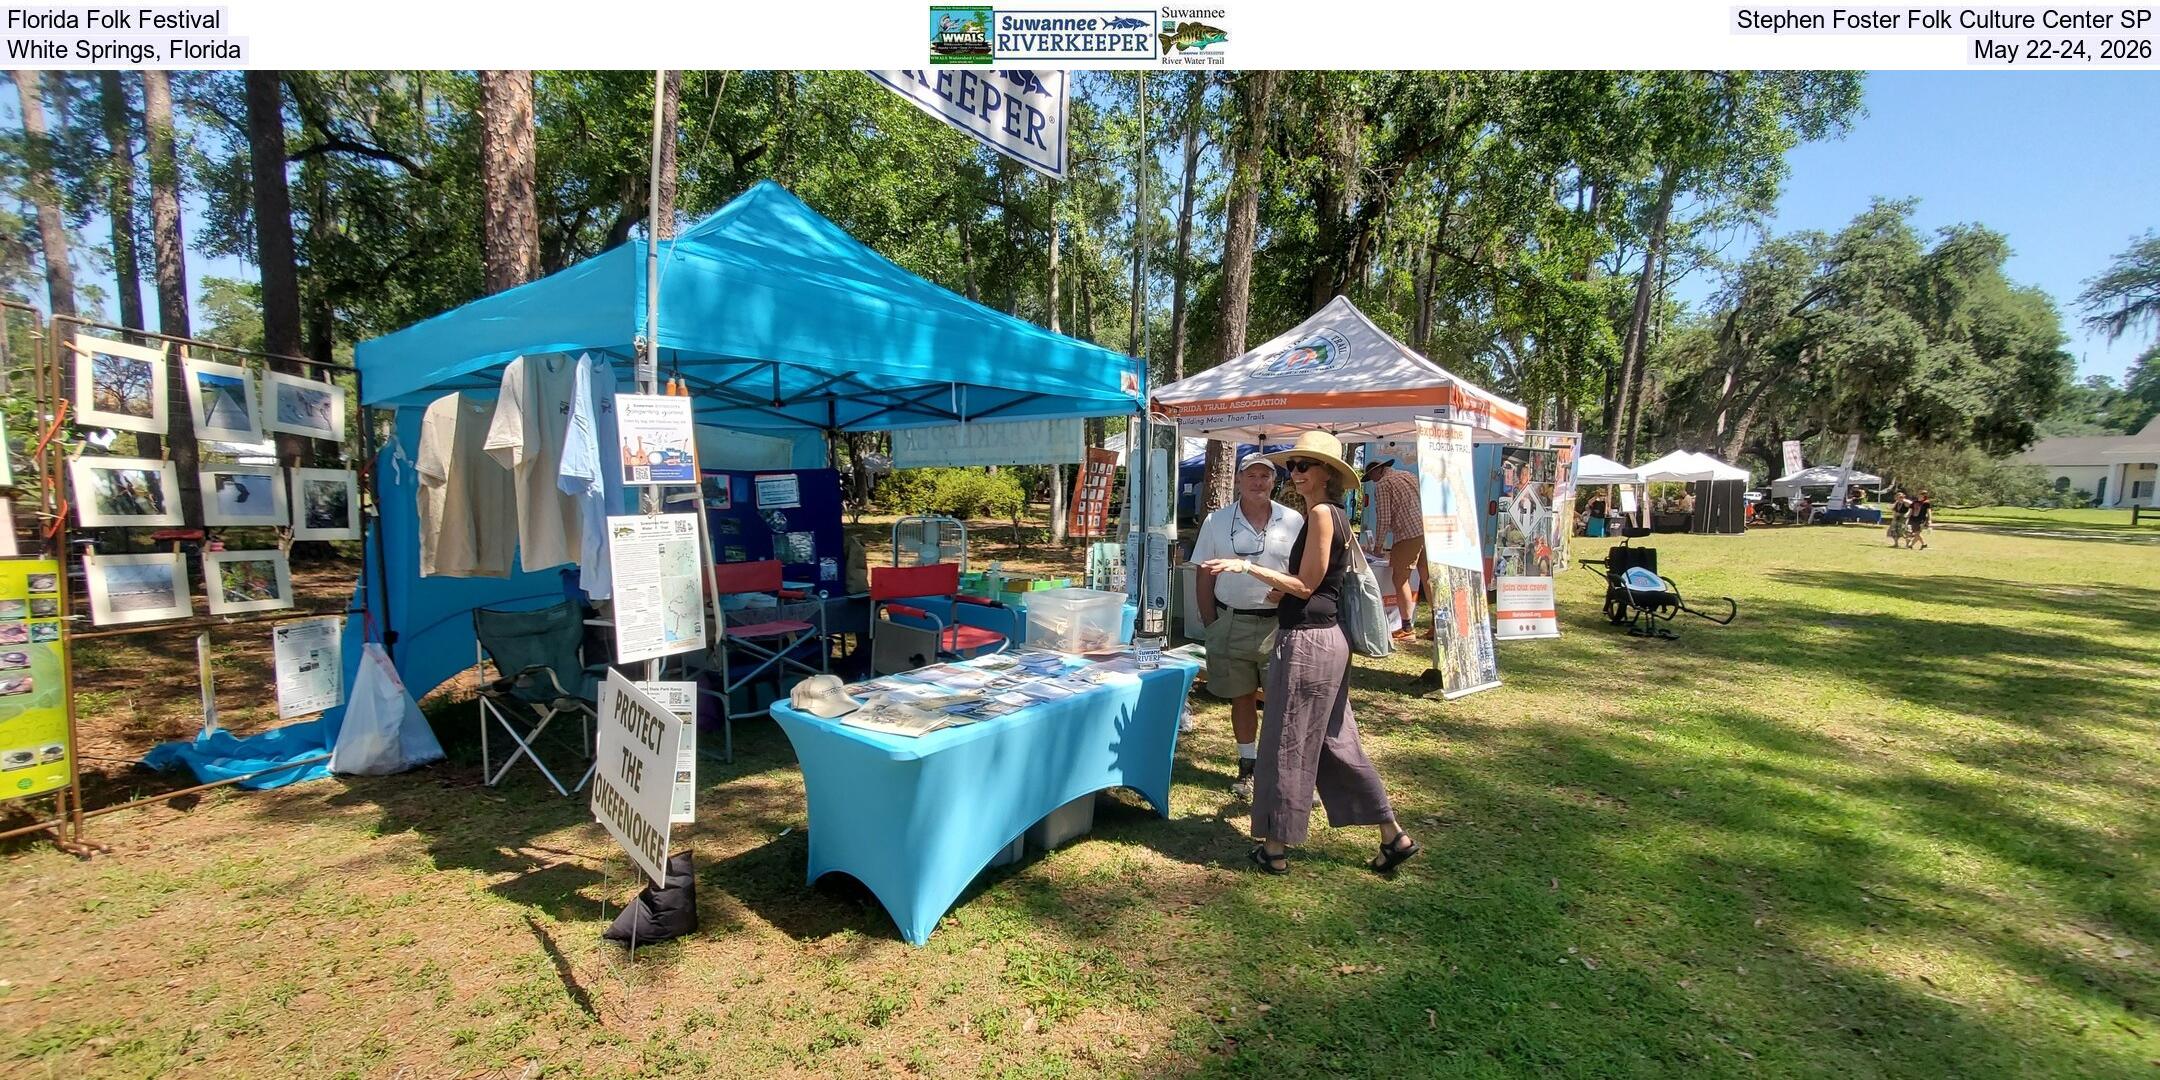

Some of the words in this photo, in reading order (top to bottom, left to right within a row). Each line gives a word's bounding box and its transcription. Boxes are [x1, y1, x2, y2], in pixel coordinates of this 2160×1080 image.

[1177, 417, 1205, 426] Building
[1227, 414, 1245, 422] Than
[1247, 413, 1265, 421] Trails
[1204, 403, 1228, 411] TRAIL
[1229, 397, 1288, 409] ASSOCIATION
[1430, 441, 1454, 452] FLORIDA
[614, 689, 665, 755] PROTECT
[620, 746, 643, 794] THE
[594, 773, 665, 871] OKEFENOKEE
